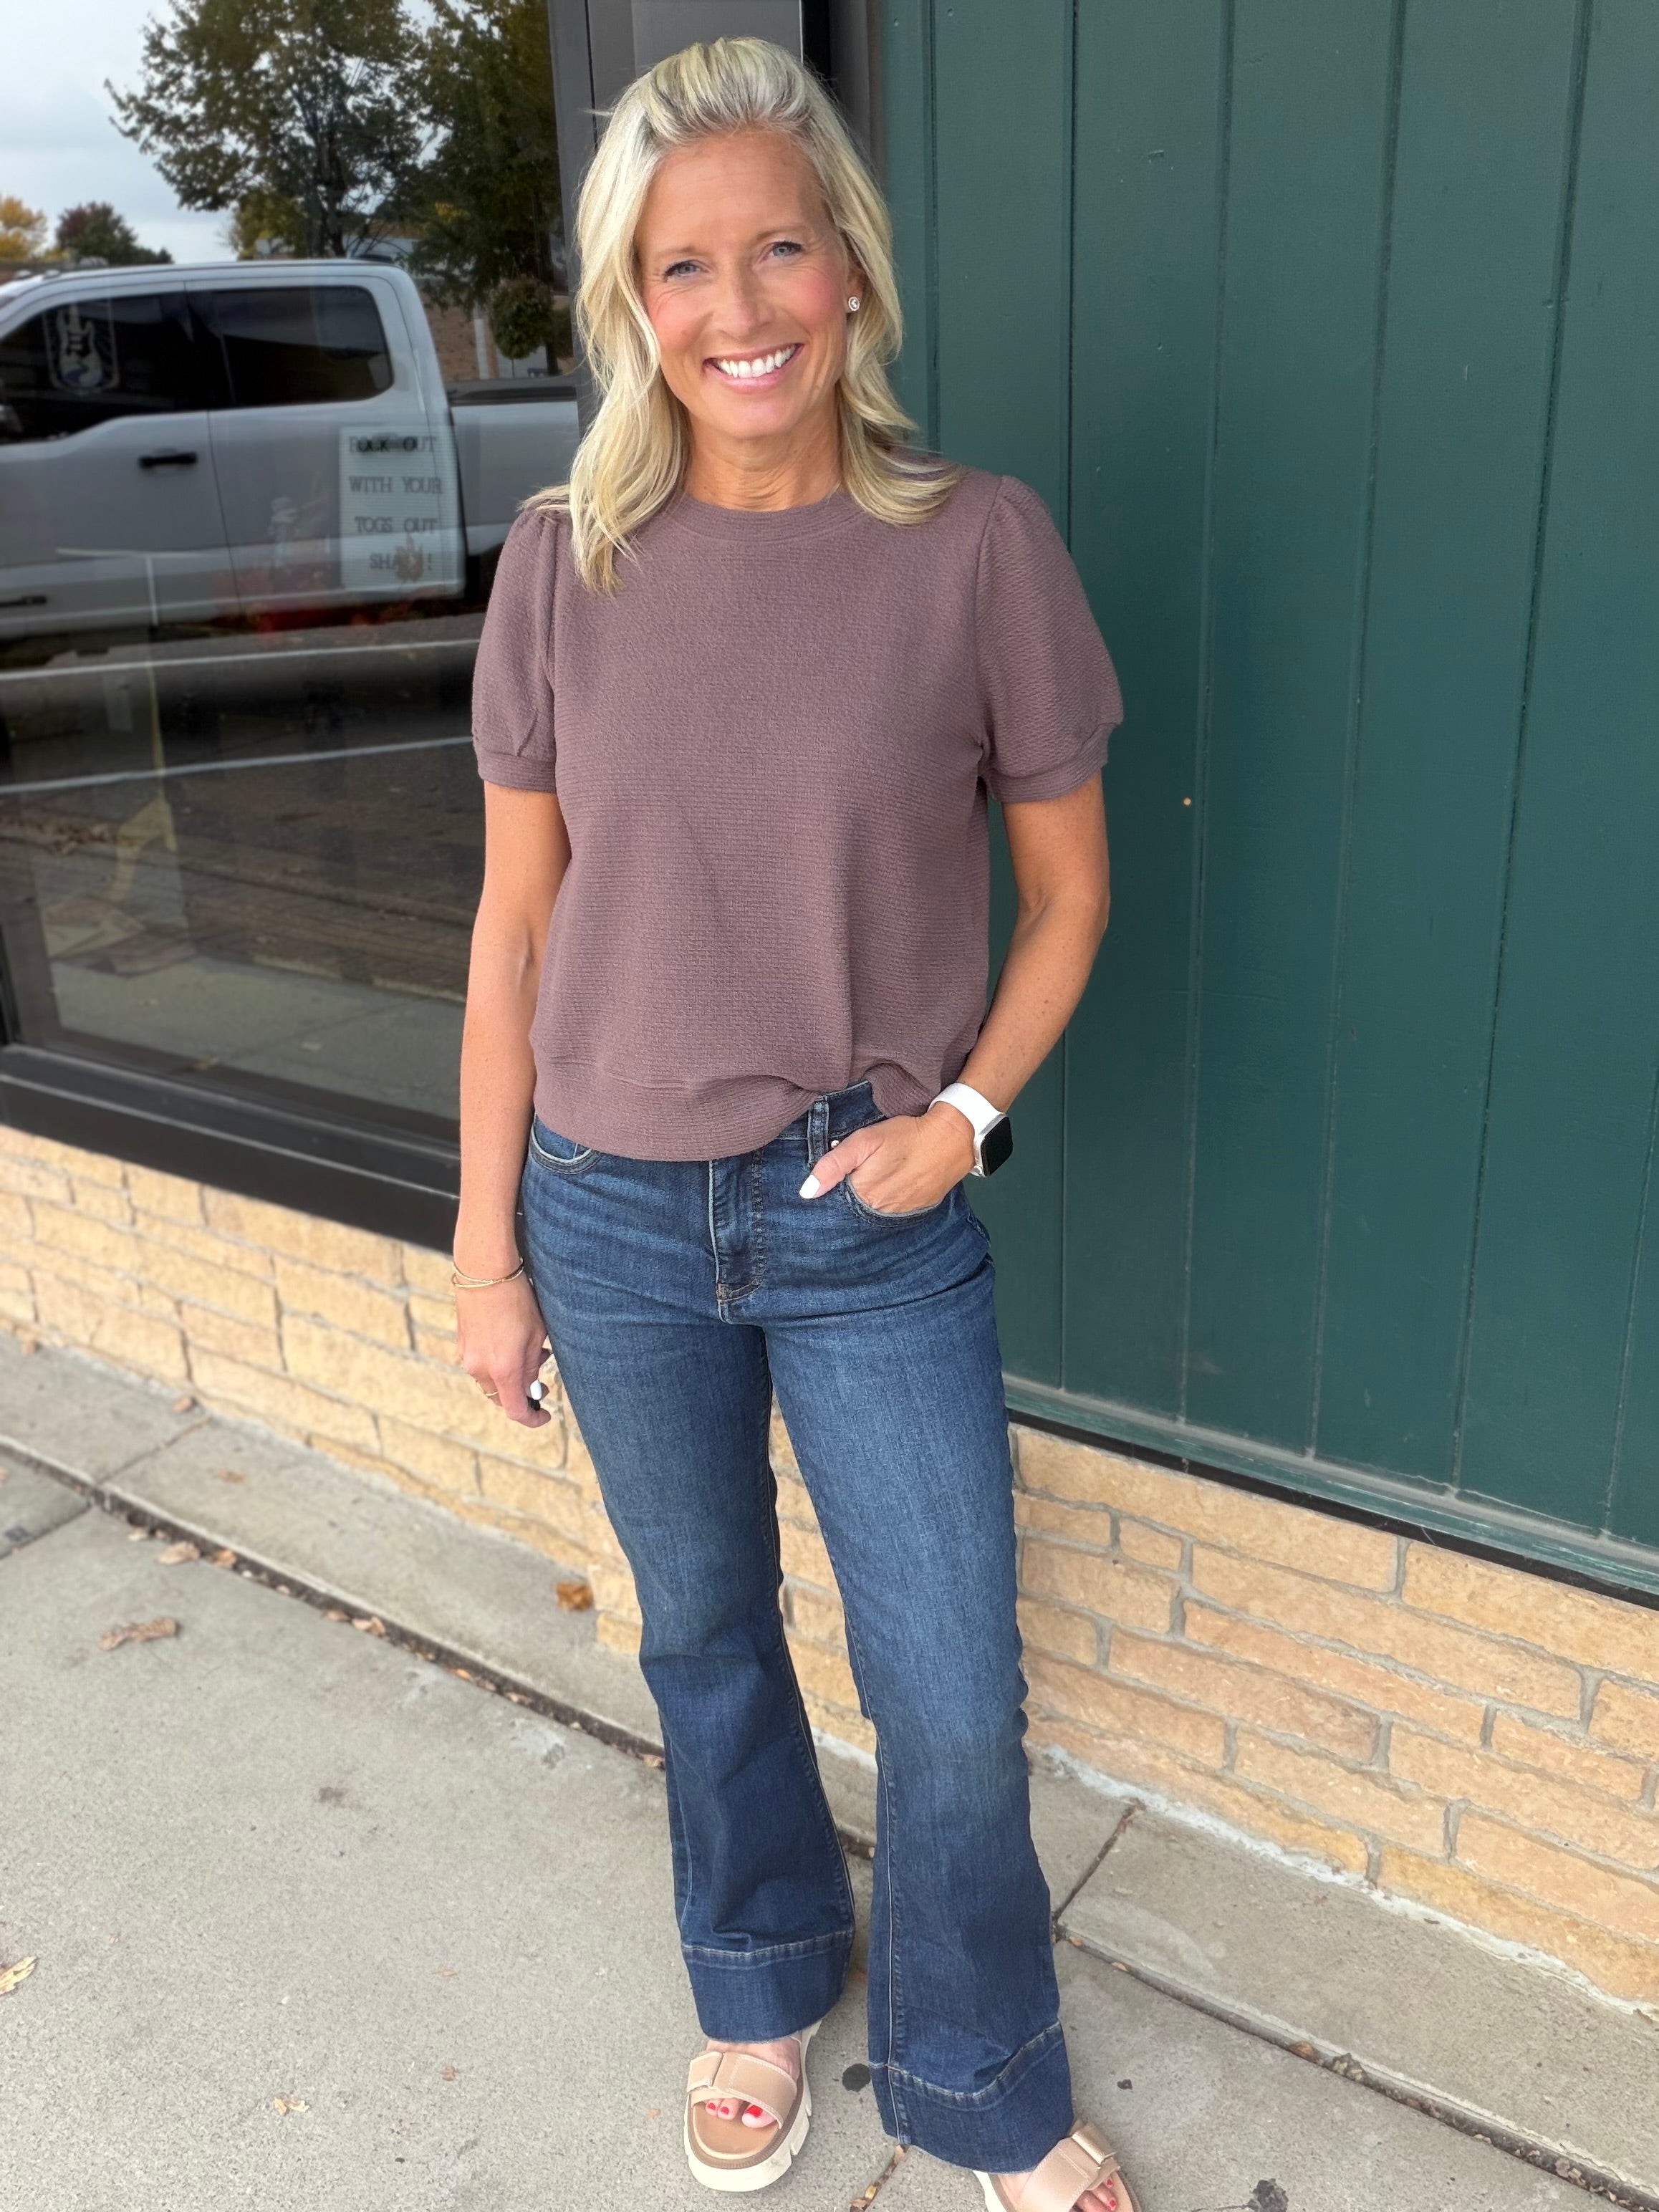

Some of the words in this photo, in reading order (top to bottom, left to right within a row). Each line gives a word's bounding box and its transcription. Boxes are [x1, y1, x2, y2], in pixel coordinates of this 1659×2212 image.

[403, 436, 437, 453] OUT
[349, 476, 393, 494] WITH
[402, 476, 442, 494] YOUR
[403, 517, 438, 534] OUT
